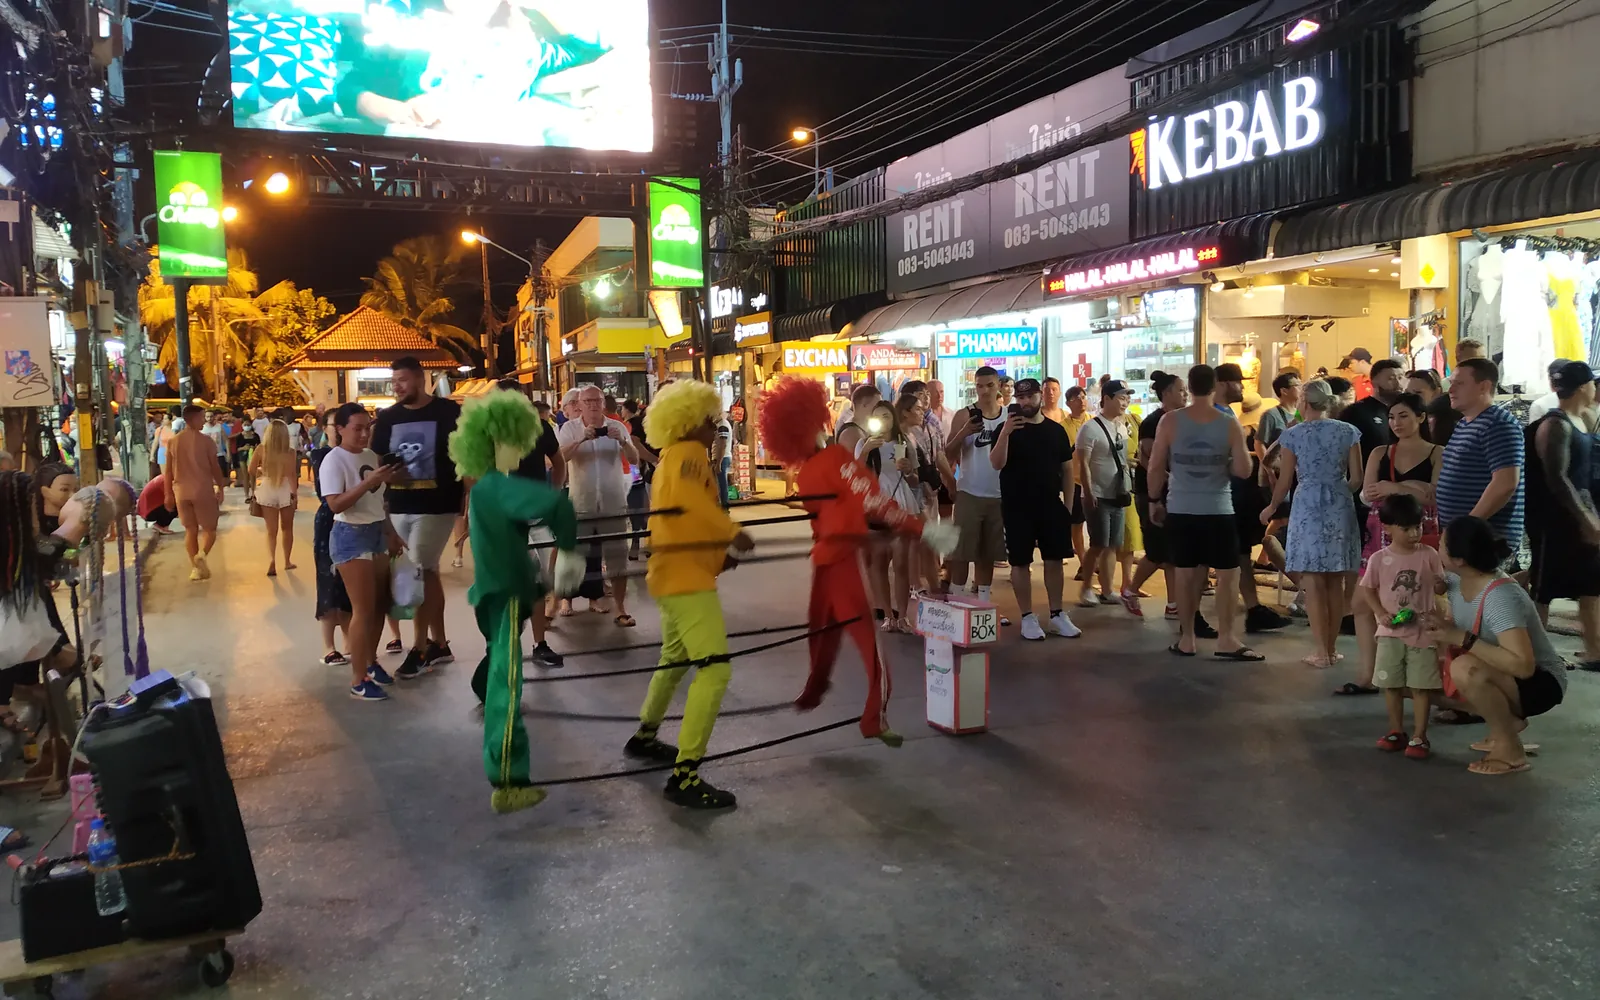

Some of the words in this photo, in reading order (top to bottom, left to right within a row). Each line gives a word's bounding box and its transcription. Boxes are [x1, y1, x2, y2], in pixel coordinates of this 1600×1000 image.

[1148, 76, 1324, 190] KEBAB
[1014, 149, 1100, 218] RENT
[903, 199, 965, 252] RENT
[1004, 203, 1110, 249] 083-5043443
[898, 239, 975, 277] 083-5043443
[959, 331, 1037, 354] PHARMACY
[971, 625, 995, 640] BOX
[974, 614, 992, 626] TIP
